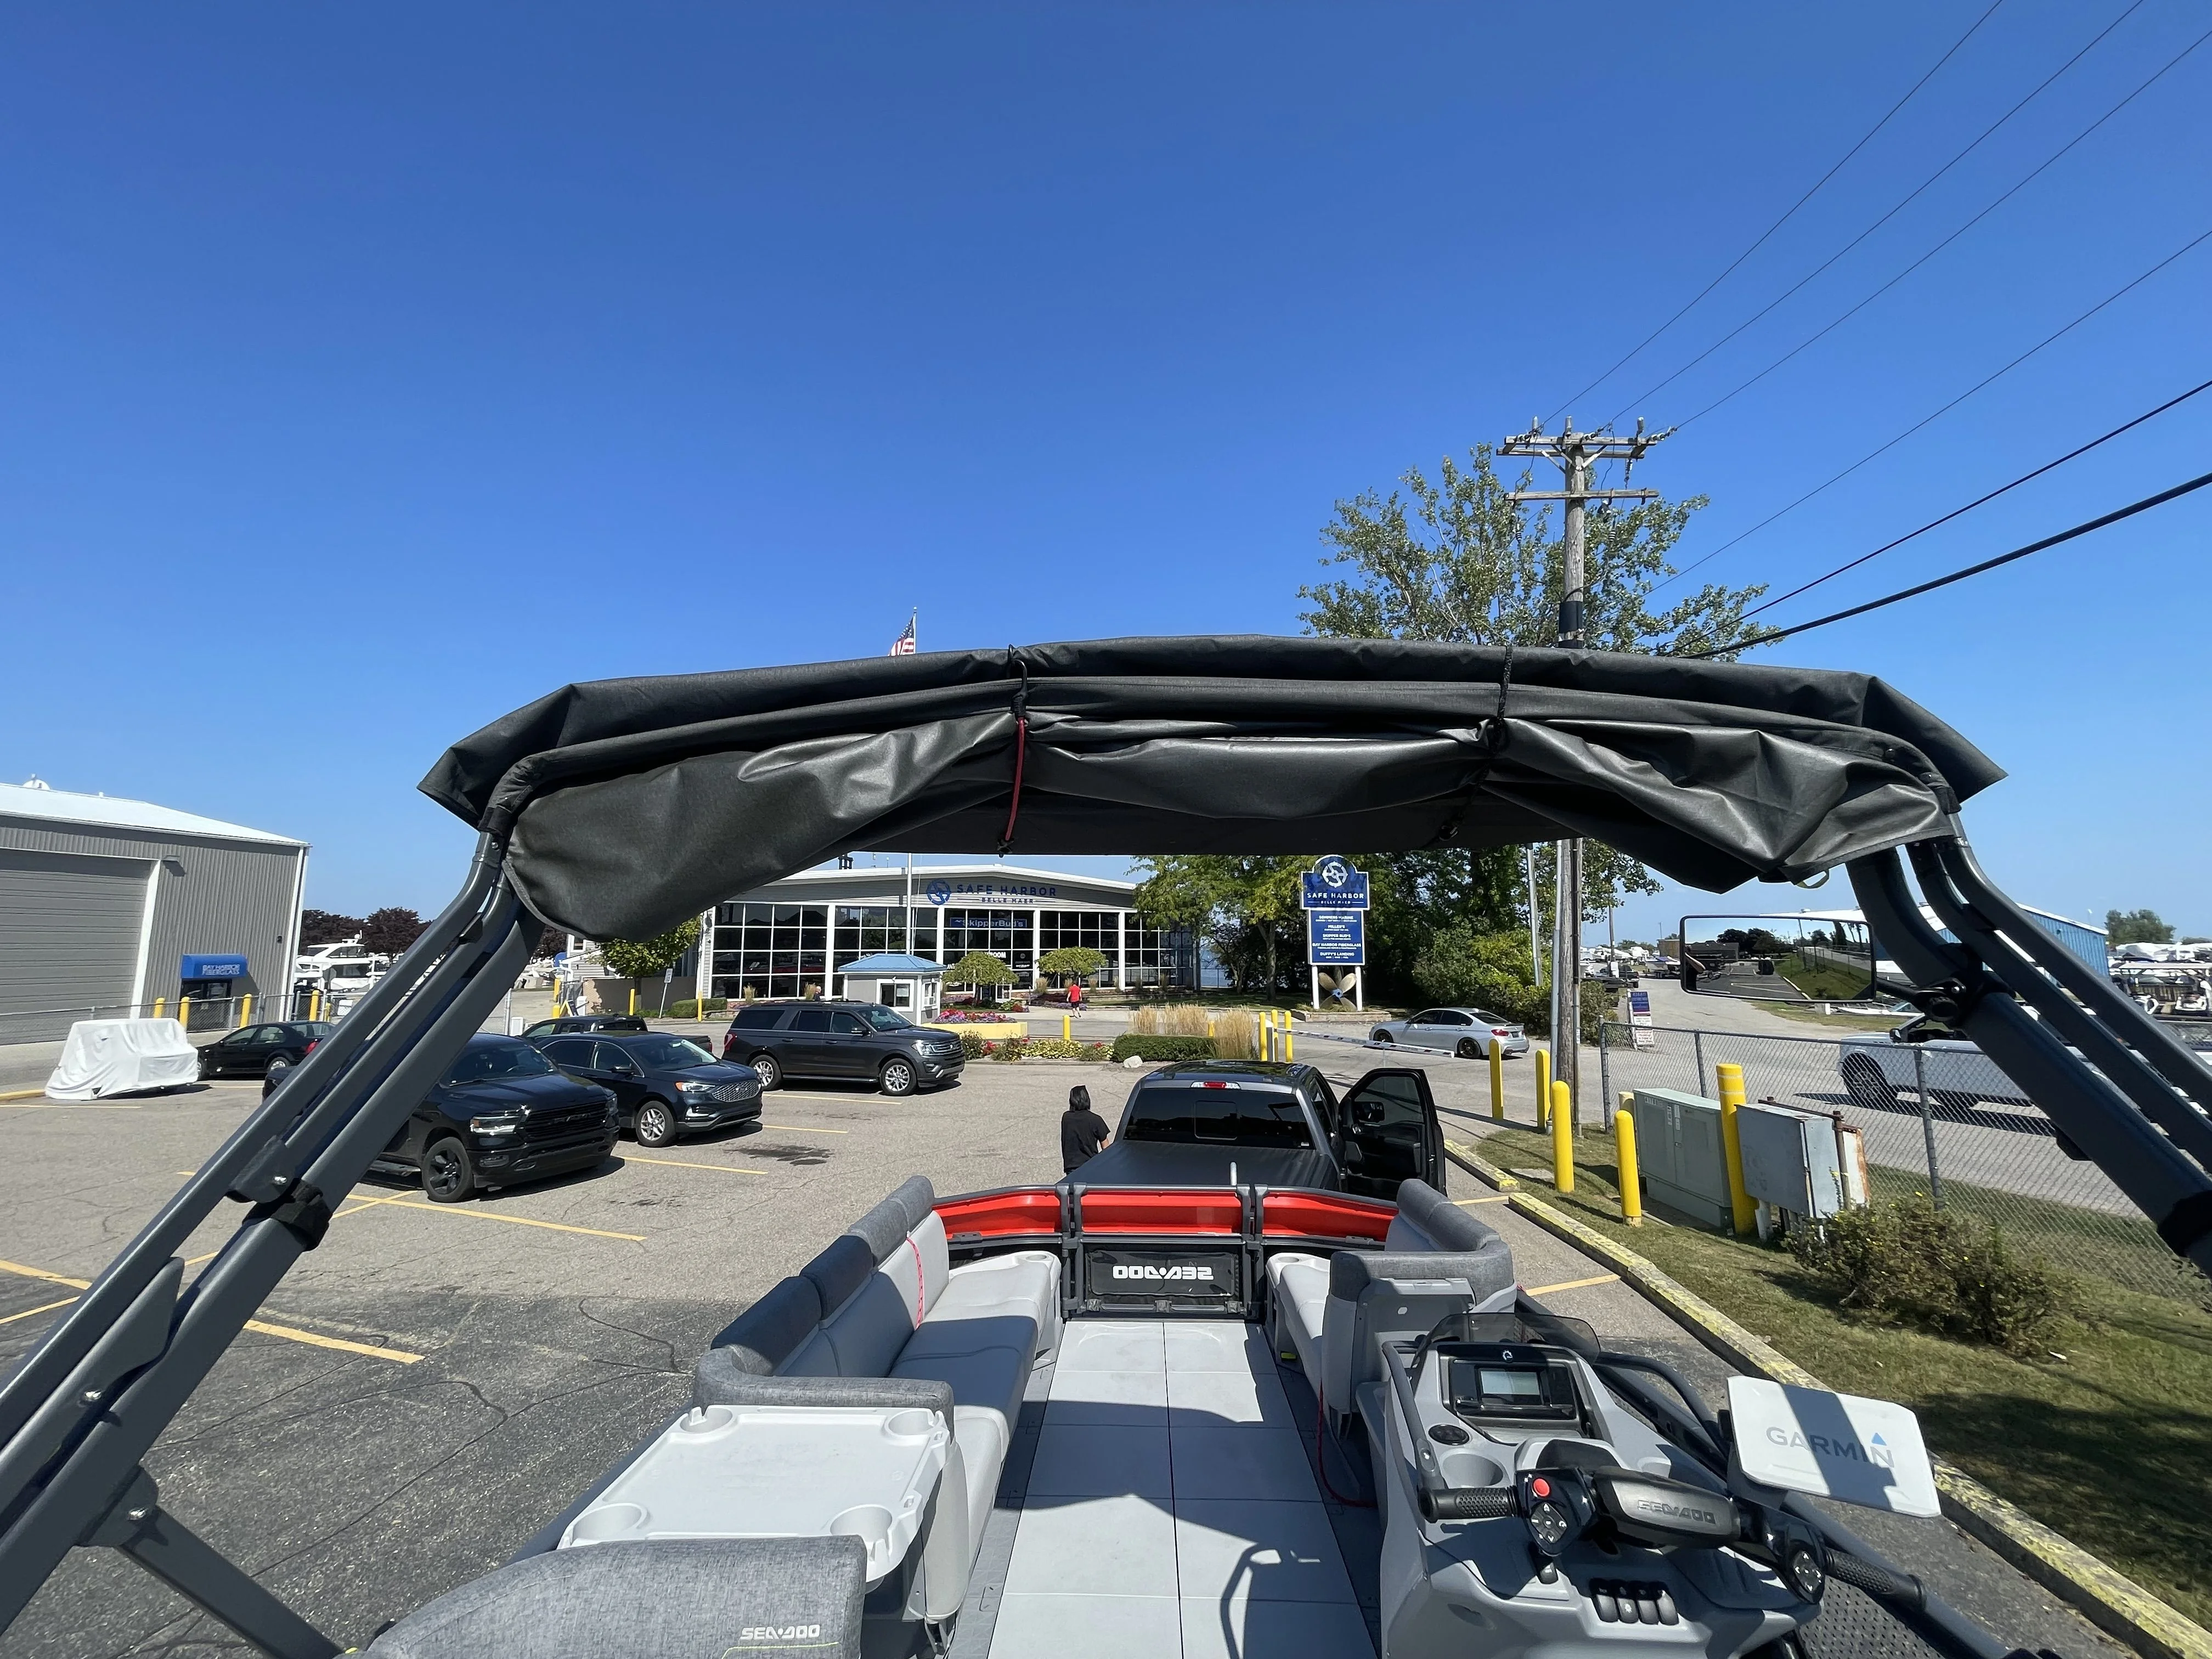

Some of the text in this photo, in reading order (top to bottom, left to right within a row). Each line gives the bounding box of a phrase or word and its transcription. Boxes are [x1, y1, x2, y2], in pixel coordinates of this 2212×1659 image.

[957, 884, 1057, 896] SAFE HARBOR
[962, 918, 1023, 928] SkipperBud's
[1765, 1426, 1895, 1469] GARMIN
